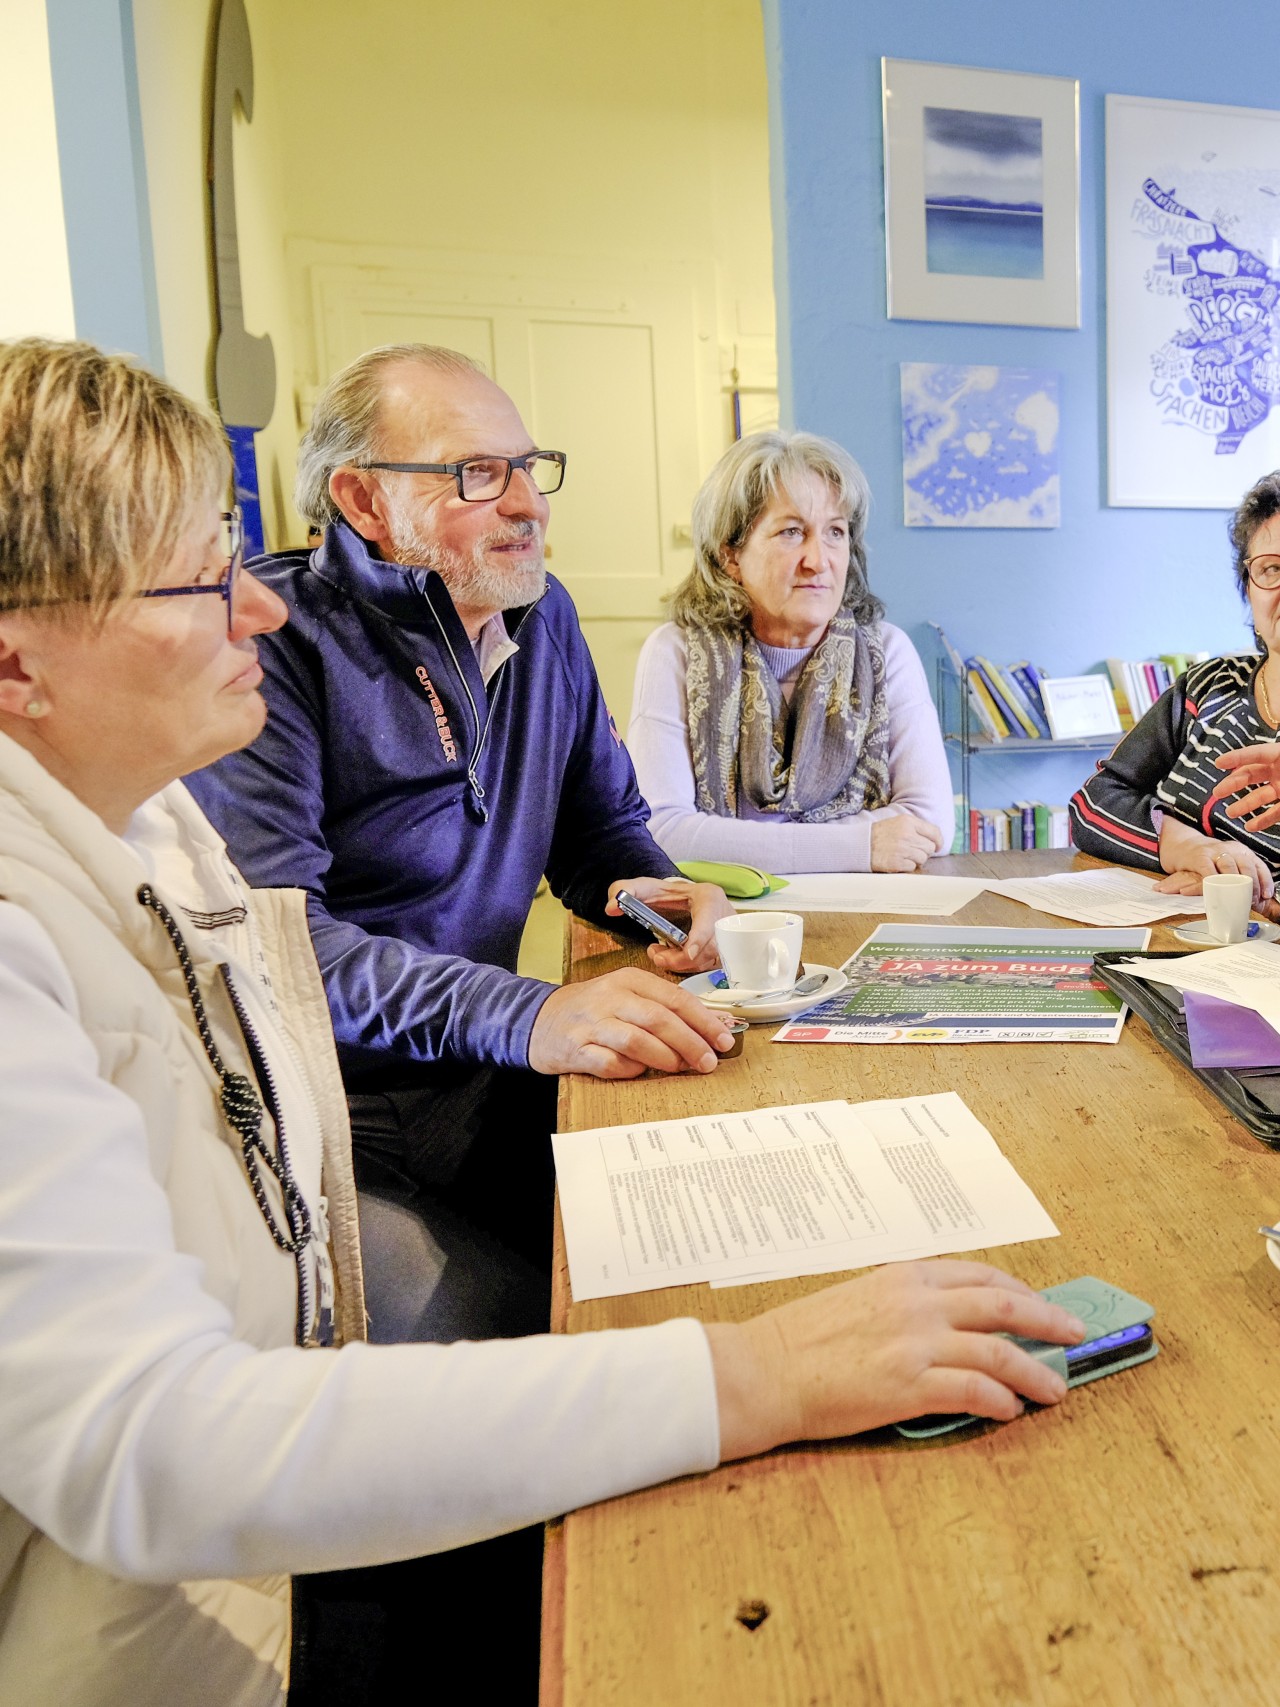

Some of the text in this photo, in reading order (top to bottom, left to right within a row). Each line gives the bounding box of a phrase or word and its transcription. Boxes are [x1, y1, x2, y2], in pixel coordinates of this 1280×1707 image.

[1149, 379, 1226, 430] STACHEN
[415, 666, 457, 763] CUTTER & BUCK
[887, 962, 1090, 975] JA zum Budg
